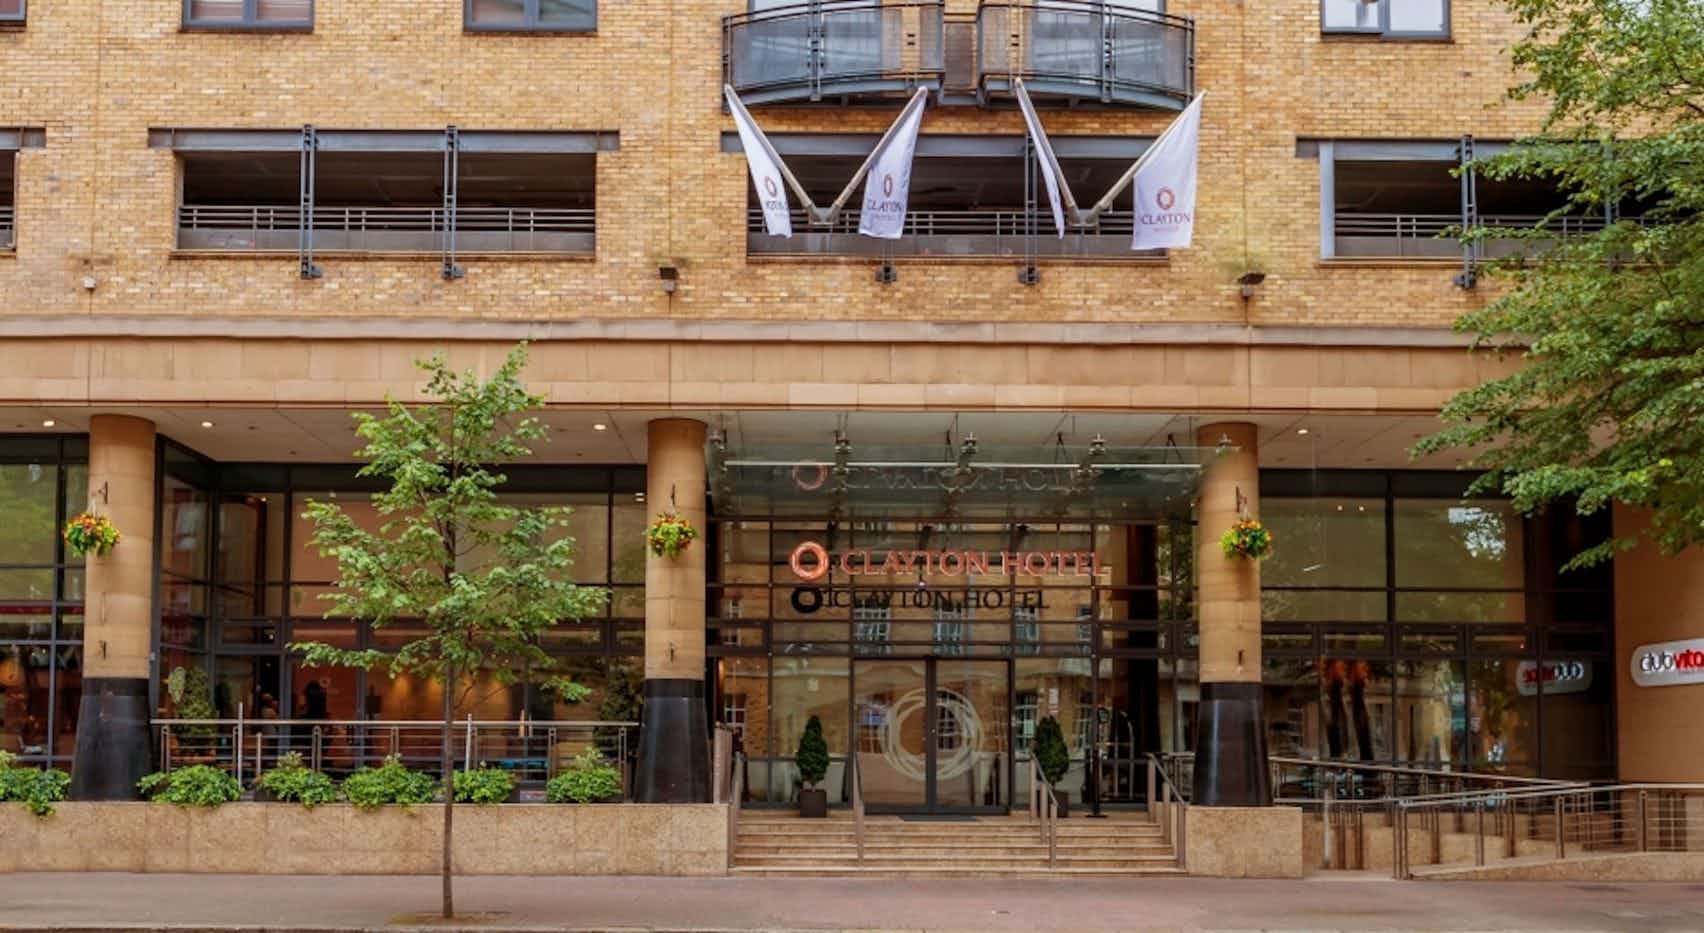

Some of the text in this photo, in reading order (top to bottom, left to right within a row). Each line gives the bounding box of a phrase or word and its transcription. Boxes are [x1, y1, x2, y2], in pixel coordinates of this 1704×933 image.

[1141, 213, 1190, 225] CLAYTON
[840, 550, 1112, 577] CLAYTON HOTEL
